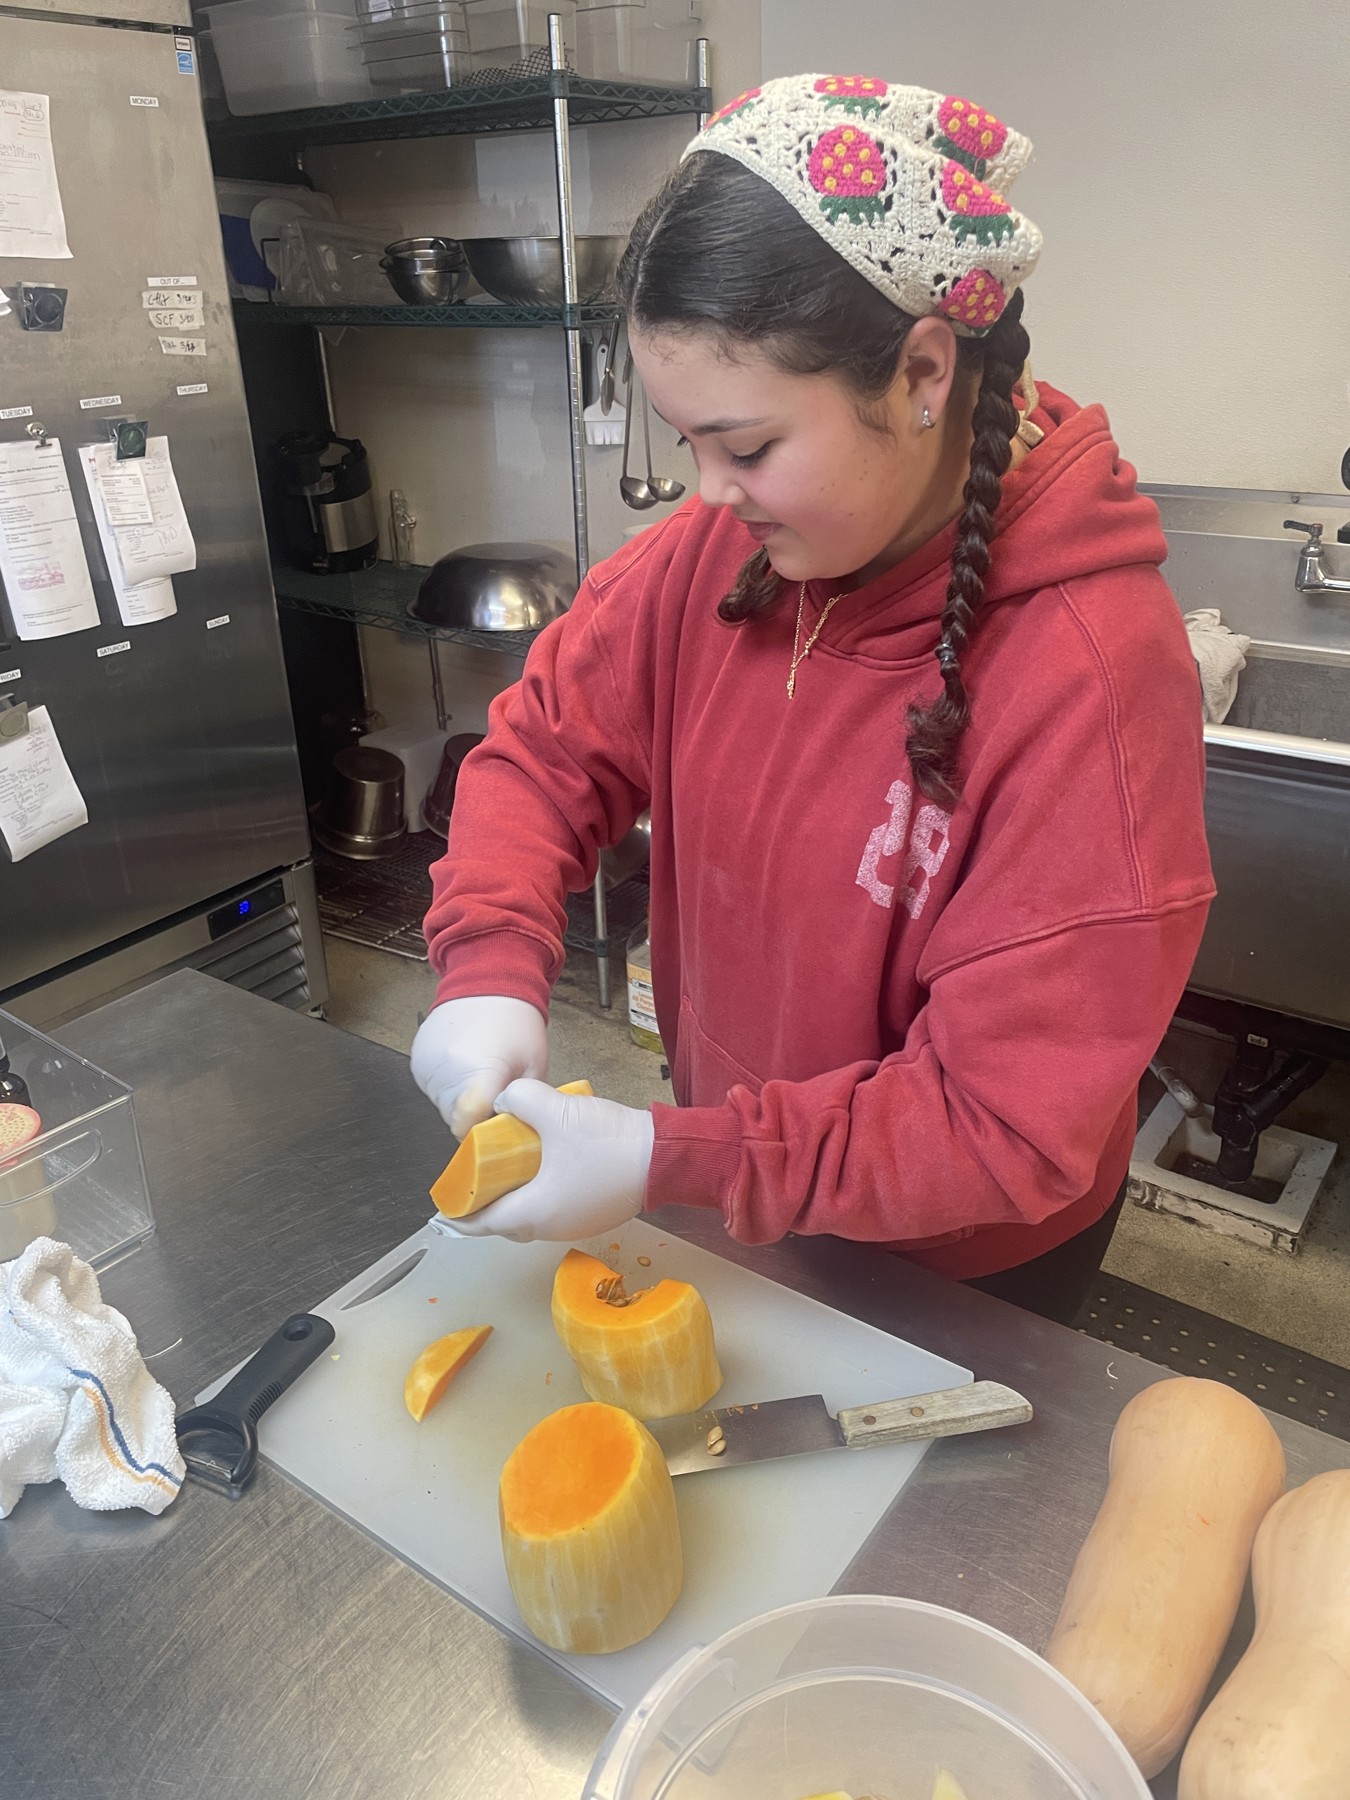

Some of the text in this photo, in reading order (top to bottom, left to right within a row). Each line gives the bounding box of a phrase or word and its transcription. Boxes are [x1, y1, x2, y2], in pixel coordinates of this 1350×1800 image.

[132, 97, 156, 105] MONDAY
[179, 386, 206, 394] THURSDAY
[82, 397, 119, 407] WEDNESDAY
[1, 408, 31, 417] TUESDAY
[208, 617, 228, 627] SUNDAY
[100, 643, 129, 655] SATURDAY
[0, 671, 19, 681] RIDAY
